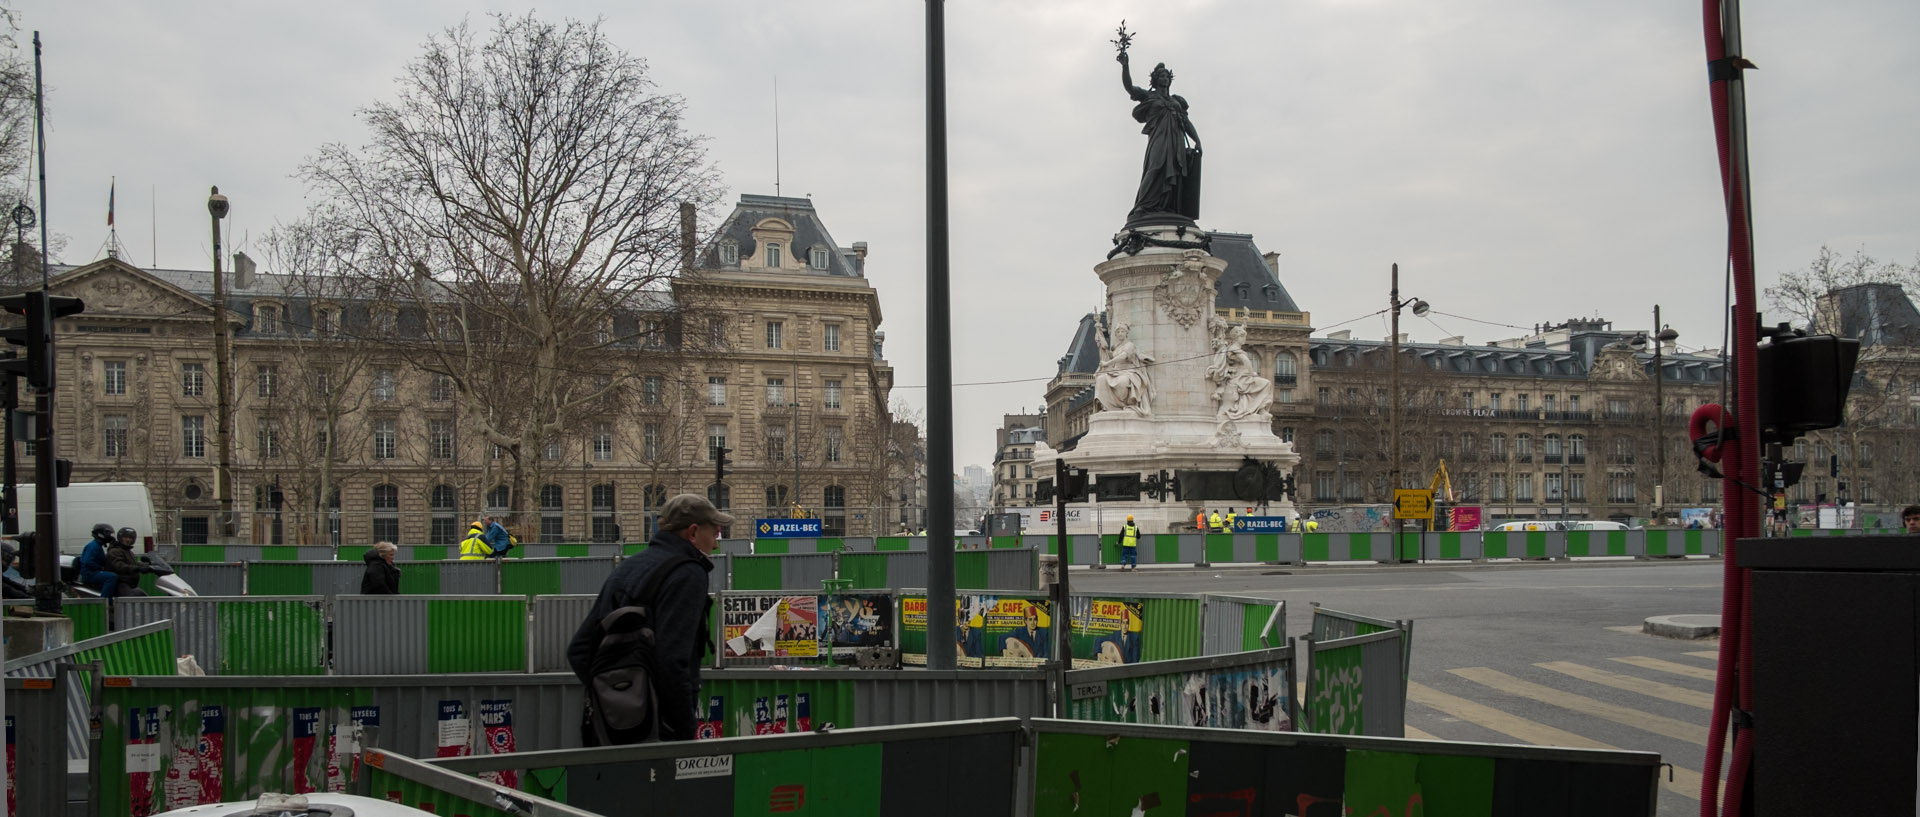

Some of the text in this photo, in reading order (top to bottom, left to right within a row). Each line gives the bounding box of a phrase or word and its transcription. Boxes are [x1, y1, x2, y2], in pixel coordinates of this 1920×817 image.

[1473, 408, 1496, 417] PLAZA
[773, 524, 819, 532] RAZEL-BEC
[1247, 520, 1284, 528] RAZEL-BEC
[724, 598, 756, 611] SETH
[760, 597, 781, 611] GU
[1003, 602, 1023, 613] CAFE
[1101, 604, 1121, 616] CAFE
[725, 613, 764, 625] ALKPOT
[725, 626, 742, 641] EN
[1077, 685, 1103, 697] TERCA
[480, 712, 504, 725] MARS
[147, 723, 158, 735] LE
